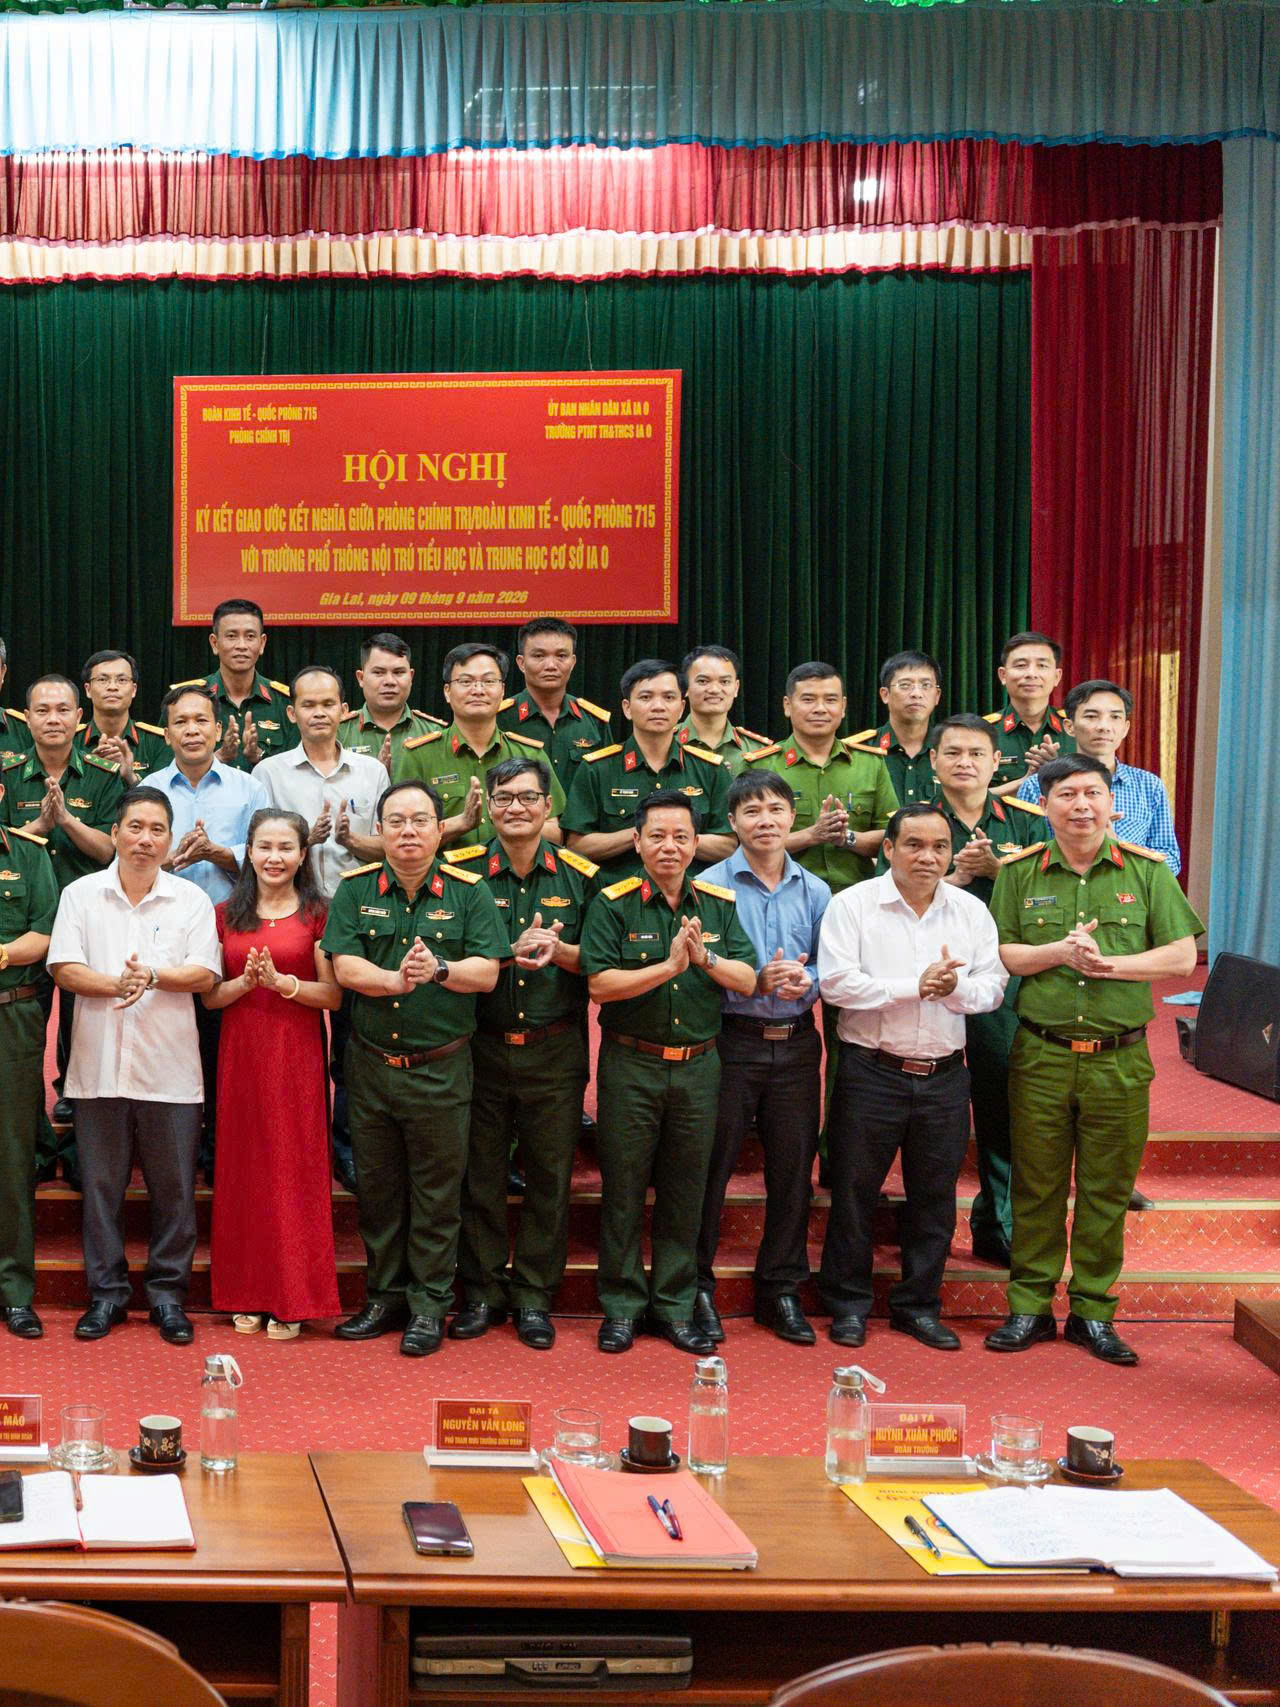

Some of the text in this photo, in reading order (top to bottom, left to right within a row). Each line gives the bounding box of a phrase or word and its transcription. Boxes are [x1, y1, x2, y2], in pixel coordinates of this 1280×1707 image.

[202, 404, 223, 421] ĐOÀN
[223, 407, 241, 421] KINH
[241, 402, 252, 421] TẾ
[257, 402, 277, 422] QUỐC
[278, 404, 302, 421] PHÒNG
[303, 407, 318, 421] 715
[560, 402, 577, 416] BAN
[578, 399, 601, 416] NHÂN
[602, 399, 619, 416] DÂN
[620, 399, 632, 416] XÃ
[230, 427, 291, 447] PHÒNG CHÍNH TRỊ
[545, 422, 576, 439] TRƯỜNG
[599, 424, 634, 439] TH&THCS
[342, 449, 508, 490] HỘI NGHỊ
[196, 504, 211, 533] KÝ
[213, 501, 234, 533] KẾT
[236, 508, 261, 532] GIAO
[264, 503, 287, 532] ƯỚC
[289, 500, 310, 532] KẾT
[311, 503, 345, 532] NGHĨA
[348, 502, 374, 531] GIỮA
[377, 500, 415, 531] PHÒNG
[417, 501, 452, 530] CHÍNH
[508, 505, 536, 529] KINH
[537, 497, 552, 529] TẾ
[561, 496, 592, 532] QUỐC
[594, 498, 633, 529] PHÒNG
[634, 504, 656, 529] 715
[241, 544, 259, 573] VỚI
[261, 542, 305, 572] TRƯỜNG
[308, 538, 330, 572] PHỔ
[332, 543, 368, 572] THÔNG
[371, 542, 391, 576] NỘI
[393, 542, 415, 571] TRÚ
[417, 538, 441, 571] TIỂU
[443, 547, 467, 576] HỌC
[468, 541, 484, 571] VÀ
[486, 546, 523, 570] TRUNG
[525, 546, 548, 575] HỌC
[551, 543, 567, 570] CƠ
[568, 536, 585, 570] SỞ
[586, 546, 599, 569] IA
[319, 590, 528, 606] Gia Lai, ngày 09 tháng 9 năm 2026
[442, 1415, 525, 1432] NGUYỄN VĂN LONG
[876, 1425, 958, 1442] HUỲNH XUÂN PHƯỚC
